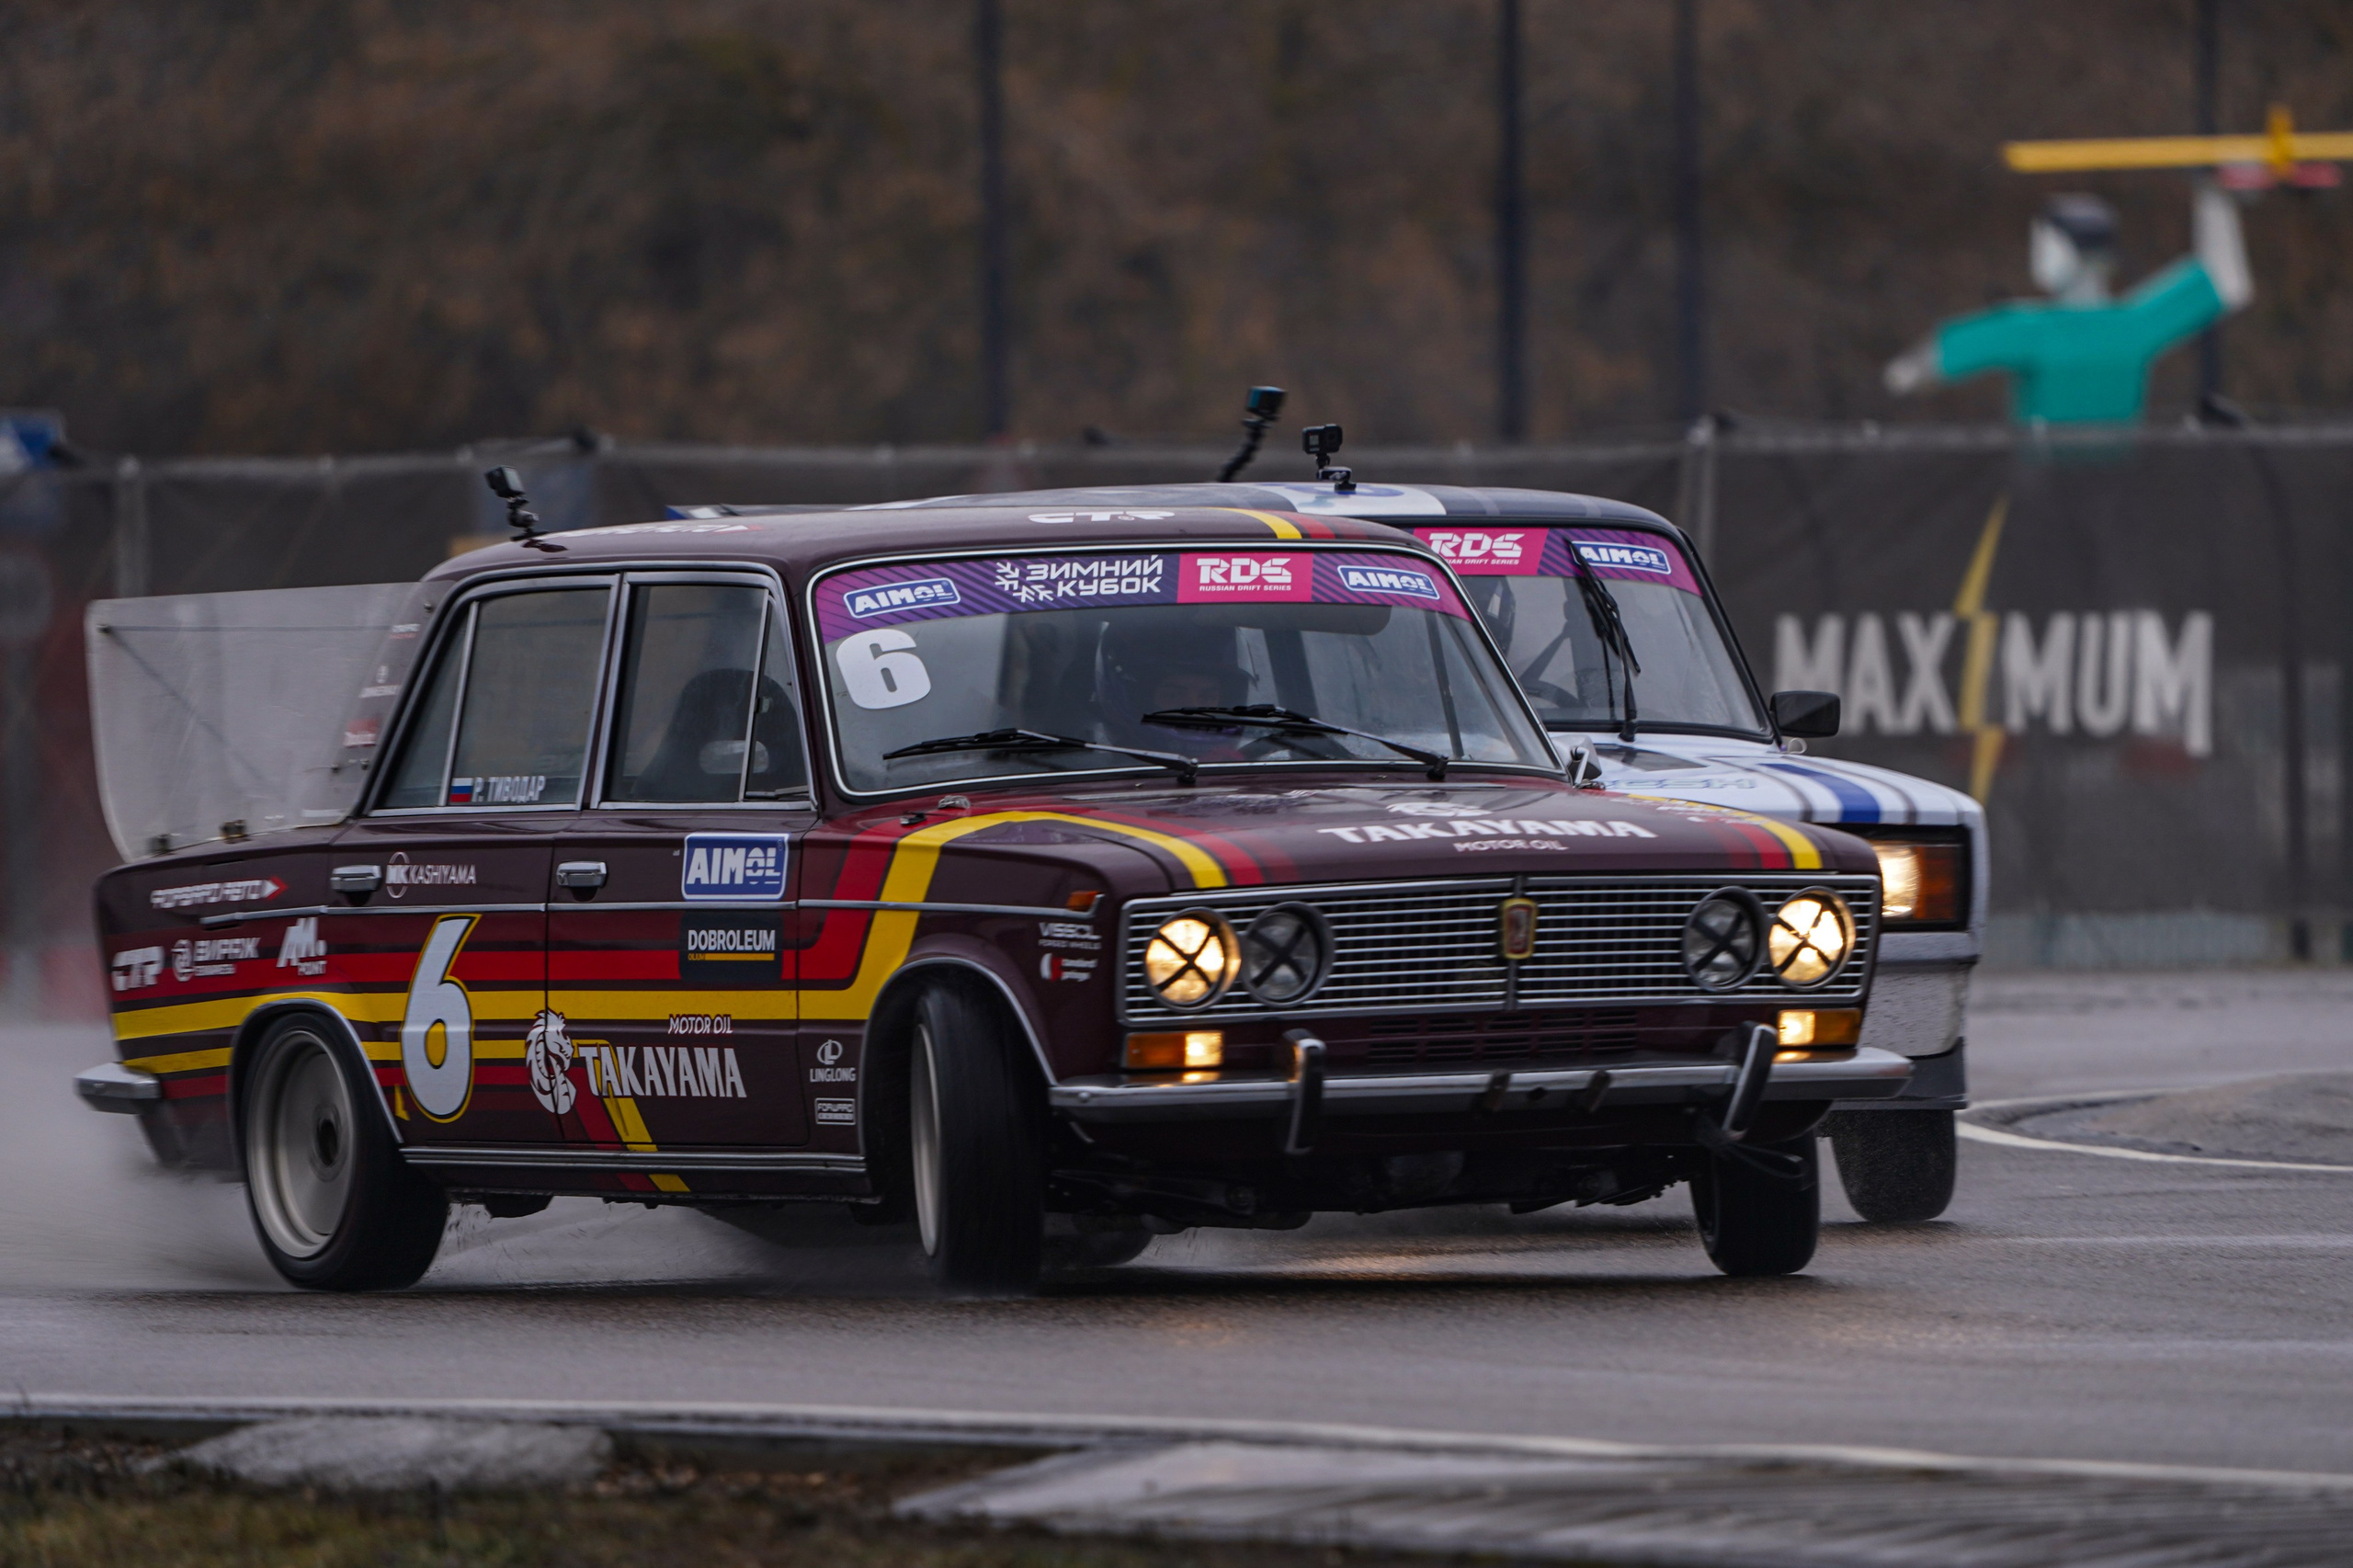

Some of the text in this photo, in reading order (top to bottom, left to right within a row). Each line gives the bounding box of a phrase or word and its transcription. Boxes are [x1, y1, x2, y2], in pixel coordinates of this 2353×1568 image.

[1428, 532, 1526, 557] RDS
[1026, 554, 1164, 582] ЗИМНИЙ
[1197, 557, 1292, 584] RDS
[1056, 575, 1162, 598] КУБОК
[1347, 571, 1435, 593] AIMOL
[855, 582, 954, 614] AIMOL
[835, 629, 931, 710] 6
[1317, 819, 1658, 843] TAKAYAMA
[1453, 838, 1569, 852] MOTOR OIL
[409, 864, 477, 884] KASHIYAMA
[686, 846, 781, 885] AIMOL
[688, 929, 776, 951] DOBROLEUM
[399, 914, 482, 1124] 6
[668, 1016, 733, 1035] MOTOR OIL
[578, 1046, 747, 1098] TAKAYAMA
[810, 1067, 856, 1083] LINGLONG
